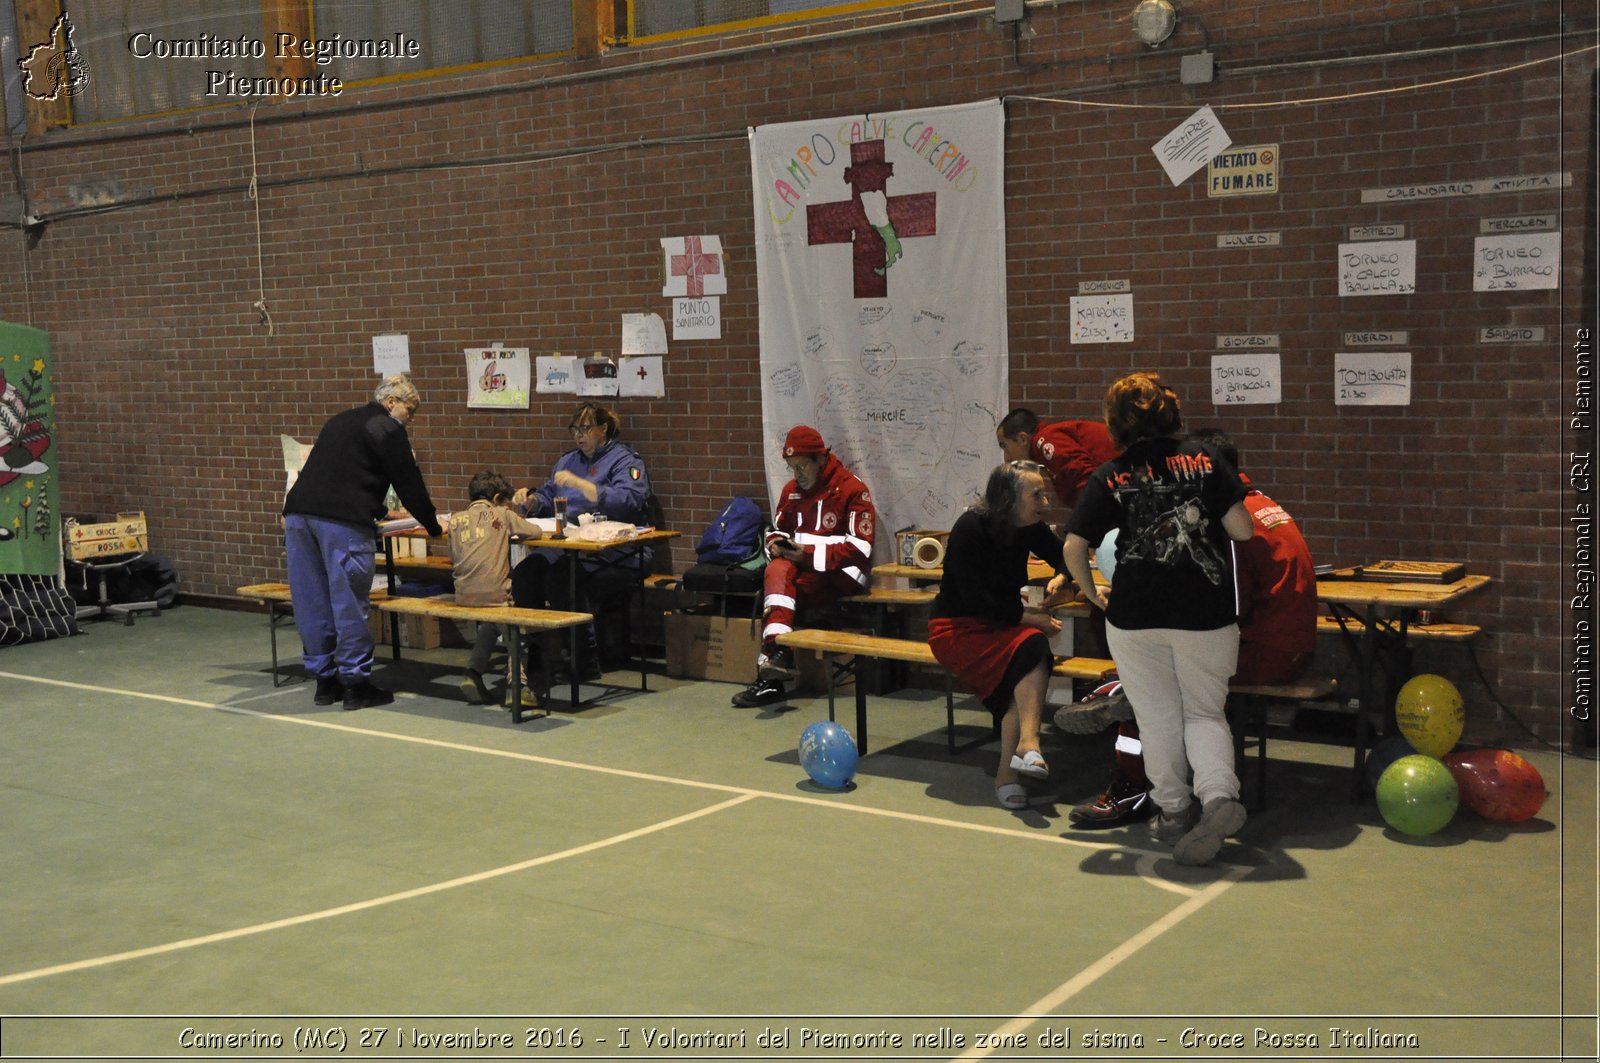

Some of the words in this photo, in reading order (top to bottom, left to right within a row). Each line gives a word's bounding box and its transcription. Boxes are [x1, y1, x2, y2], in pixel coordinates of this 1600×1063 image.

[1163, 118, 1209, 154] SEMPRE
[1213, 152, 1257, 169] VIETATO
[767, 133, 835, 225] CAMPO
[903, 120, 977, 192] CAMERINO
[1213, 173, 1273, 190] FUMARE
[1386, 184, 1473, 199] CALENDARIO
[1343, 253, 1399, 268] TORNEO
[1480, 247, 1542, 262] TORNEO
[1356, 268, 1400, 280] CALCIO
[1493, 264, 1553, 280] BURRACO
[1345, 279, 1397, 293] BALILLA
[680, 301, 710, 315] PUNTO
[1077, 307, 1127, 319] KARAOKE
[675, 315, 716, 328] SANITARIO
[1485, 330, 1533, 340] SABATO
[1215, 367, 1260, 379] TORNEO
[1338, 365, 1406, 385] TOMBOLATA
[1227, 380, 1271, 393] BRISCOLA
[867, 409, 907, 422] MARCHE
[96, 528, 116, 537] CROCE
[98, 542, 126, 552] ROSSA
